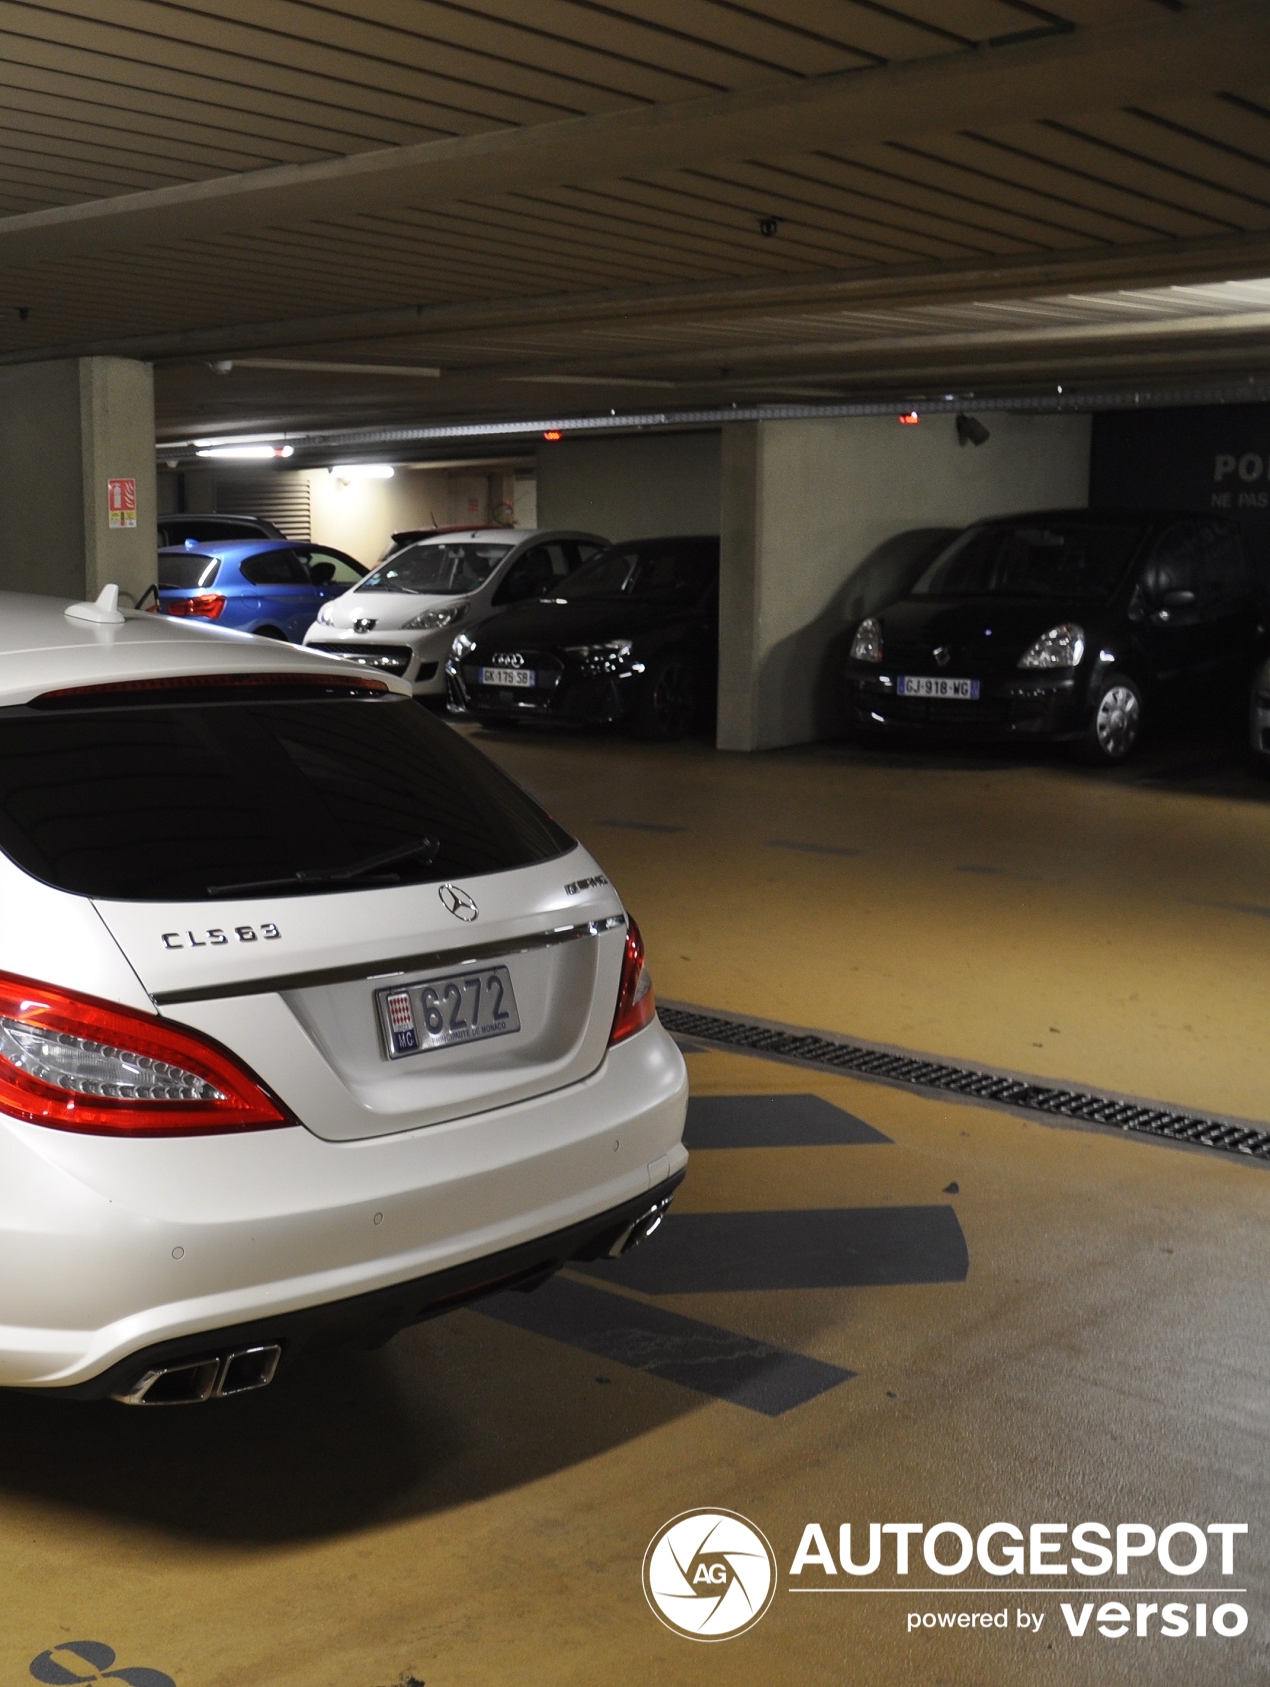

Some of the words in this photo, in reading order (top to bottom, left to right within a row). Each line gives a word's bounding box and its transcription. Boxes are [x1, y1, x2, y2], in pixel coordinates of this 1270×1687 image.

[1214, 453, 1270, 482] PO
[1211, 492, 1231, 508] NE
[1238, 492, 1269, 508] PAS
[161, 928, 229, 949] CLS
[235, 923, 282, 943] 63
[422, 975, 510, 1035] 6272
[481, 1021, 507, 1033] MONACO
[398, 1031, 413, 1048] MC
